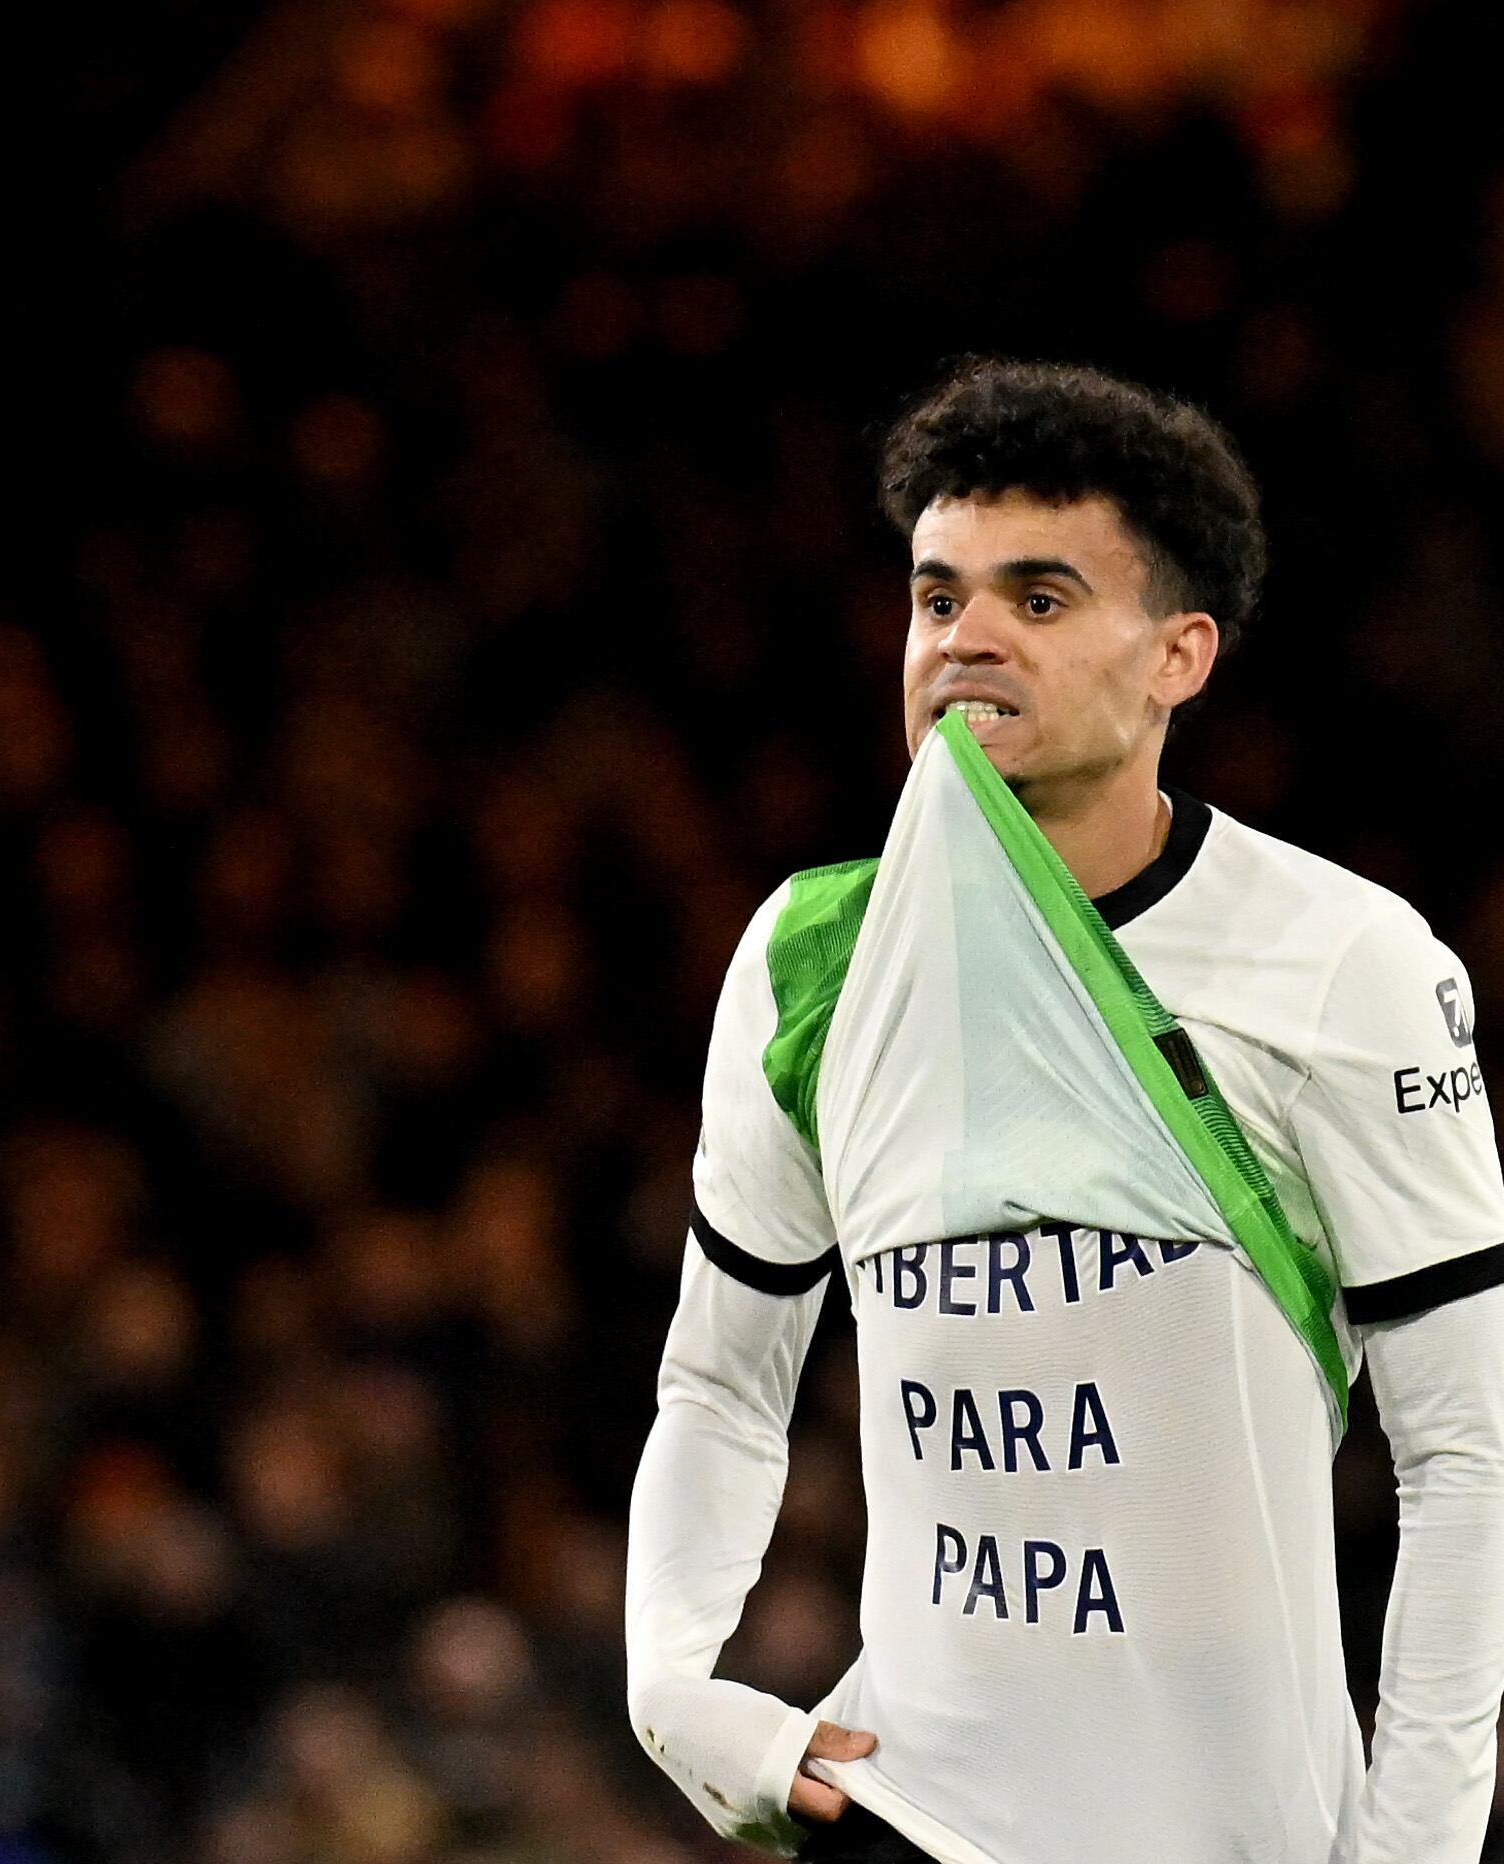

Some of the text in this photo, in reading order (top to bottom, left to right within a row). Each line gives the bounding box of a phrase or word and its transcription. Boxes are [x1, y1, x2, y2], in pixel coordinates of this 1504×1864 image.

[857, 1221, 1201, 1317] IBERTA
[901, 1379, 1121, 1472] PARA
[932, 1523, 1125, 1635] PAPA
